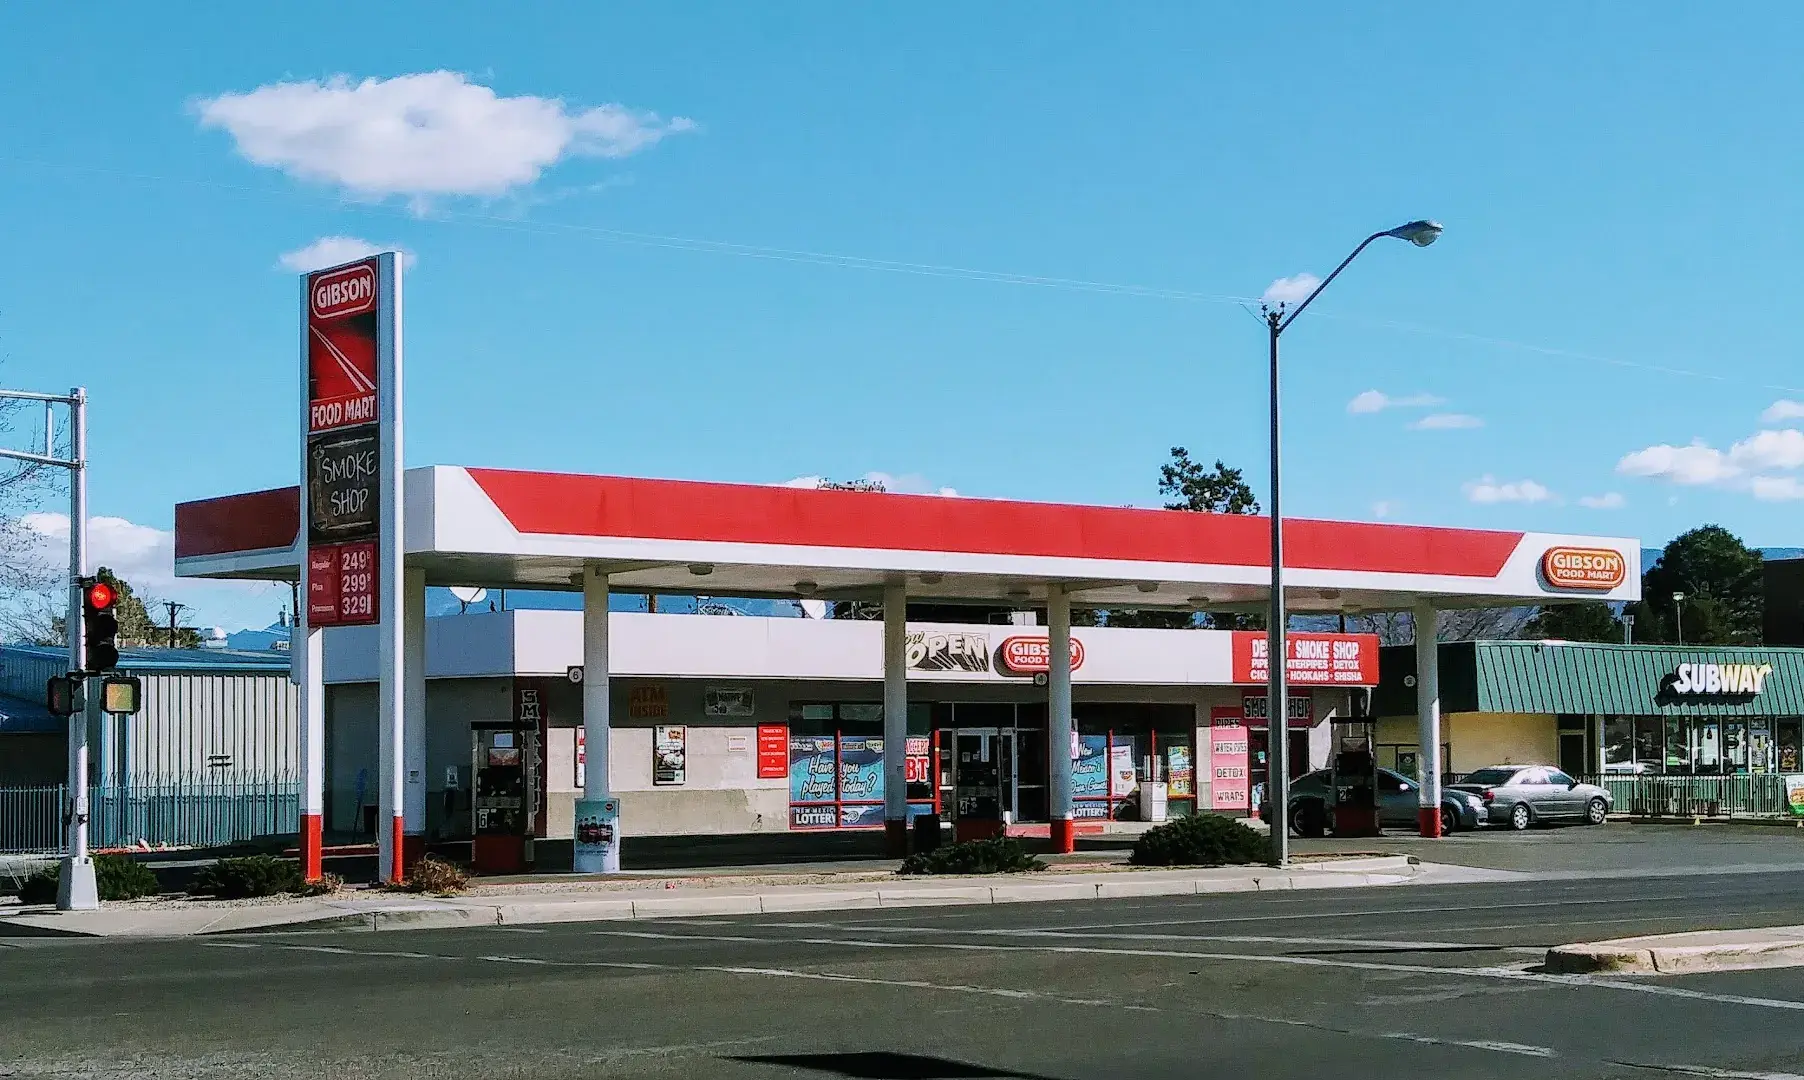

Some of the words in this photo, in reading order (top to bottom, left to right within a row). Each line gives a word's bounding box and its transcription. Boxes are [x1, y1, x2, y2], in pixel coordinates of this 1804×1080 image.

[316, 275, 371, 309] GIBSON
[311, 402, 342, 427] FOOD
[345, 395, 376, 422] MART
[321, 450, 377, 484] SMOKE
[330, 487, 369, 517] SHOP
[1553, 555, 1619, 571] GIBSON
[1557, 570, 1585, 578] FOOD
[1587, 570, 1615, 580] MART
[905, 634, 985, 669] OPEN
[1295, 640, 1329, 658] SMOKE
[1333, 641, 1359, 659] SHOP
[1014, 656, 1043, 664] FOOD
[1333, 660, 1359, 670] DETOX
[1290, 671, 1329, 681] HOOKAHS
[1334, 671, 1362, 682] SHISHA
[1672, 661, 1773, 694] SUBWAY
[1215, 719, 1240, 729] PIPES
[1079, 743, 1092, 757] New
[808, 754, 834, 774] Have
[840, 763, 859, 778] you
[1216, 768, 1244, 778] DETOX
[801, 775, 835, 799] played
[841, 772, 877, 797] today?
[1217, 791, 1244, 801] WRAPS
[795, 813, 836, 825] LOTTERY
[1072, 808, 1104, 818] LOTTERY
